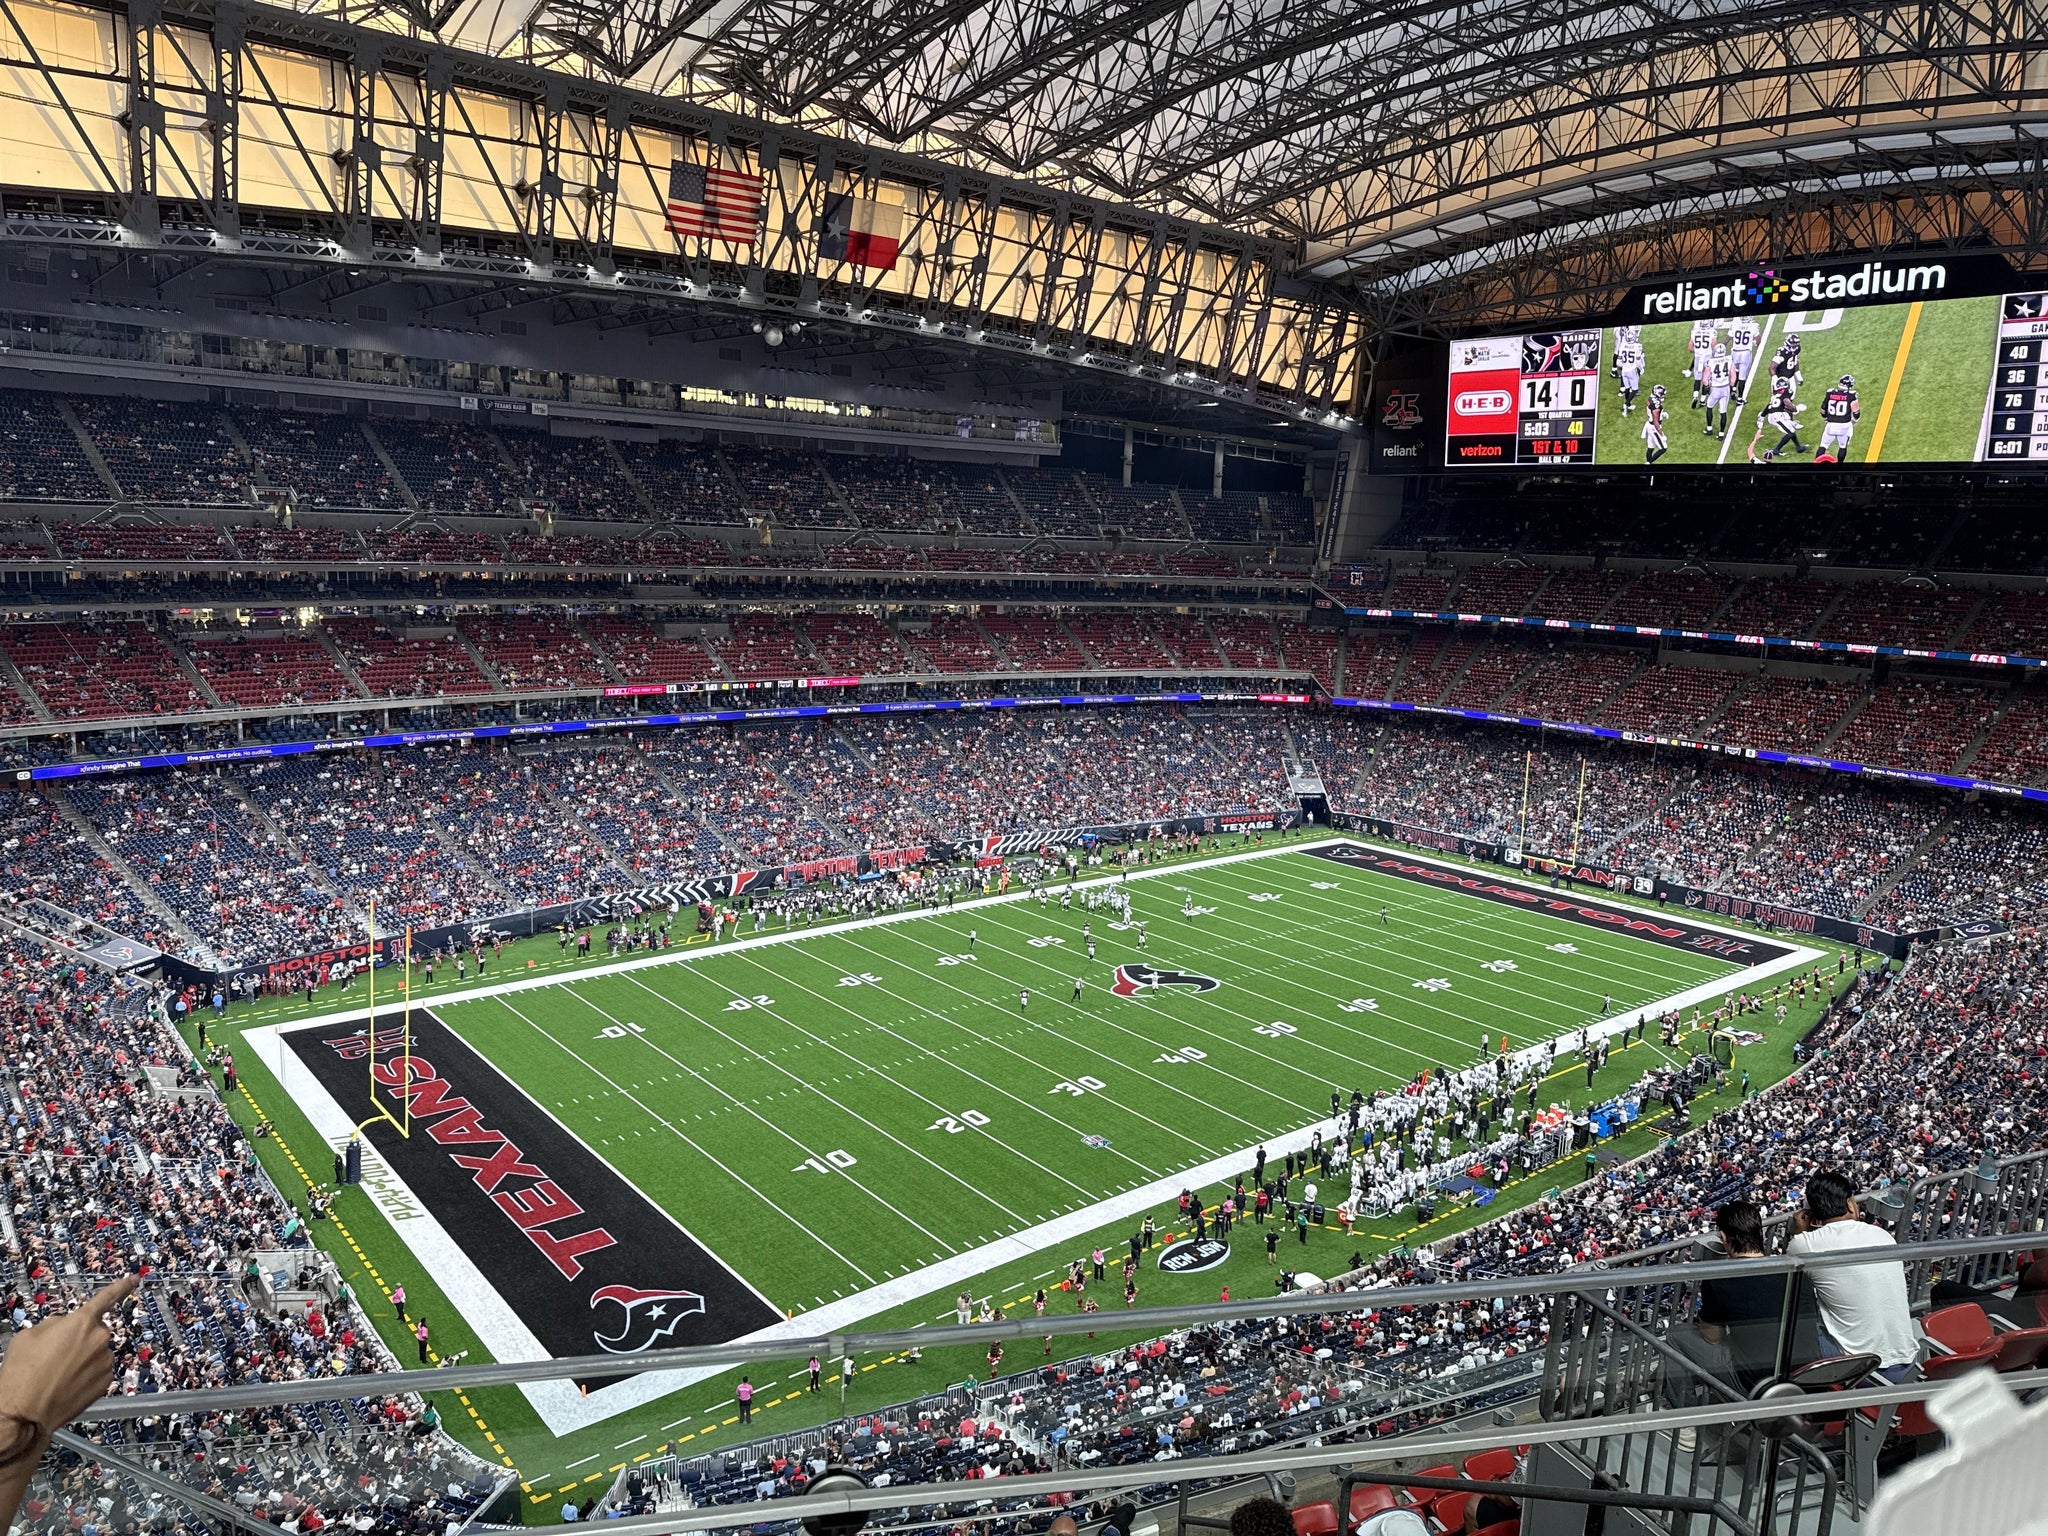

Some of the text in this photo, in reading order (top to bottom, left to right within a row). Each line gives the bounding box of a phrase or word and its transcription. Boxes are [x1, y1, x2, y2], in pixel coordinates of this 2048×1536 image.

[1643, 262, 1946, 315] reliant stadium
[1563, 333, 1599, 342] RAIDERS
[1695, 336, 1710, 349] 55
[1734, 331, 1750, 345] 96
[1621, 350, 1635, 364] 35
[2010, 346, 2028, 359] 40
[1713, 362, 1729, 378] 44
[2007, 370, 2025, 383] 36
[1527, 381, 1552, 408] 14
[1570, 379, 1585, 406] 0
[2005, 394, 2022, 407] 76
[1549, 411, 1572, 419] QUARTER
[1524, 422, 1549, 436] 5:03
[1568, 421, 1583, 435] 40
[2006, 418, 2016, 431] 6
[1383, 445, 1417, 456] reliant
[1460, 444, 1501, 456] verizon
[1532, 440, 1578, 454] 1ST & 10
[1994, 441, 2022, 454] 6:01
[314, 742, 331, 750] xfinity
[331, 740, 352, 749] Imagine
[199, 754, 215, 762] years.
[228, 751, 242, 760] price.
[253, 748, 272, 757] audibles.
[80, 759, 141, 773] xfinity Imagine That
[1973, 782, 1989, 790] xfinity
[1990, 784, 2010, 793] Imagine
[1220, 814, 1275, 824] HOUSTON
[1220, 820, 1274, 832] TEXANS
[869, 848, 926, 870] TEXANS
[1507, 851, 1521, 863] 39
[1528, 857, 1632, 890] TEXANS
[1637, 878, 1651, 892] 39
[1375, 860, 1687, 939] HOUSTON
[1732, 899, 1751, 918] UP
[1027, 936, 1065, 947] 50
[268, 942, 384, 974] HOUSTON
[938, 954, 977, 966] 40
[1481, 959, 1518, 973] 20
[839, 972, 883, 987] 30
[1412, 977, 1453, 993] 30
[728, 995, 776, 1011] 20
[1337, 998, 1379, 1014] 40
[602, 1022, 646, 1038] 10
[1252, 1020, 1298, 1038] 50
[1160, 1046, 1207, 1065] 40
[1056, 1075, 1106, 1096] 30
[936, 1109, 991, 1134] 20
[805, 1149, 857, 1173] 10
[369, 1055, 618, 1282] TEXANS
[1162, 1240, 1226, 1271] RCM JSM
